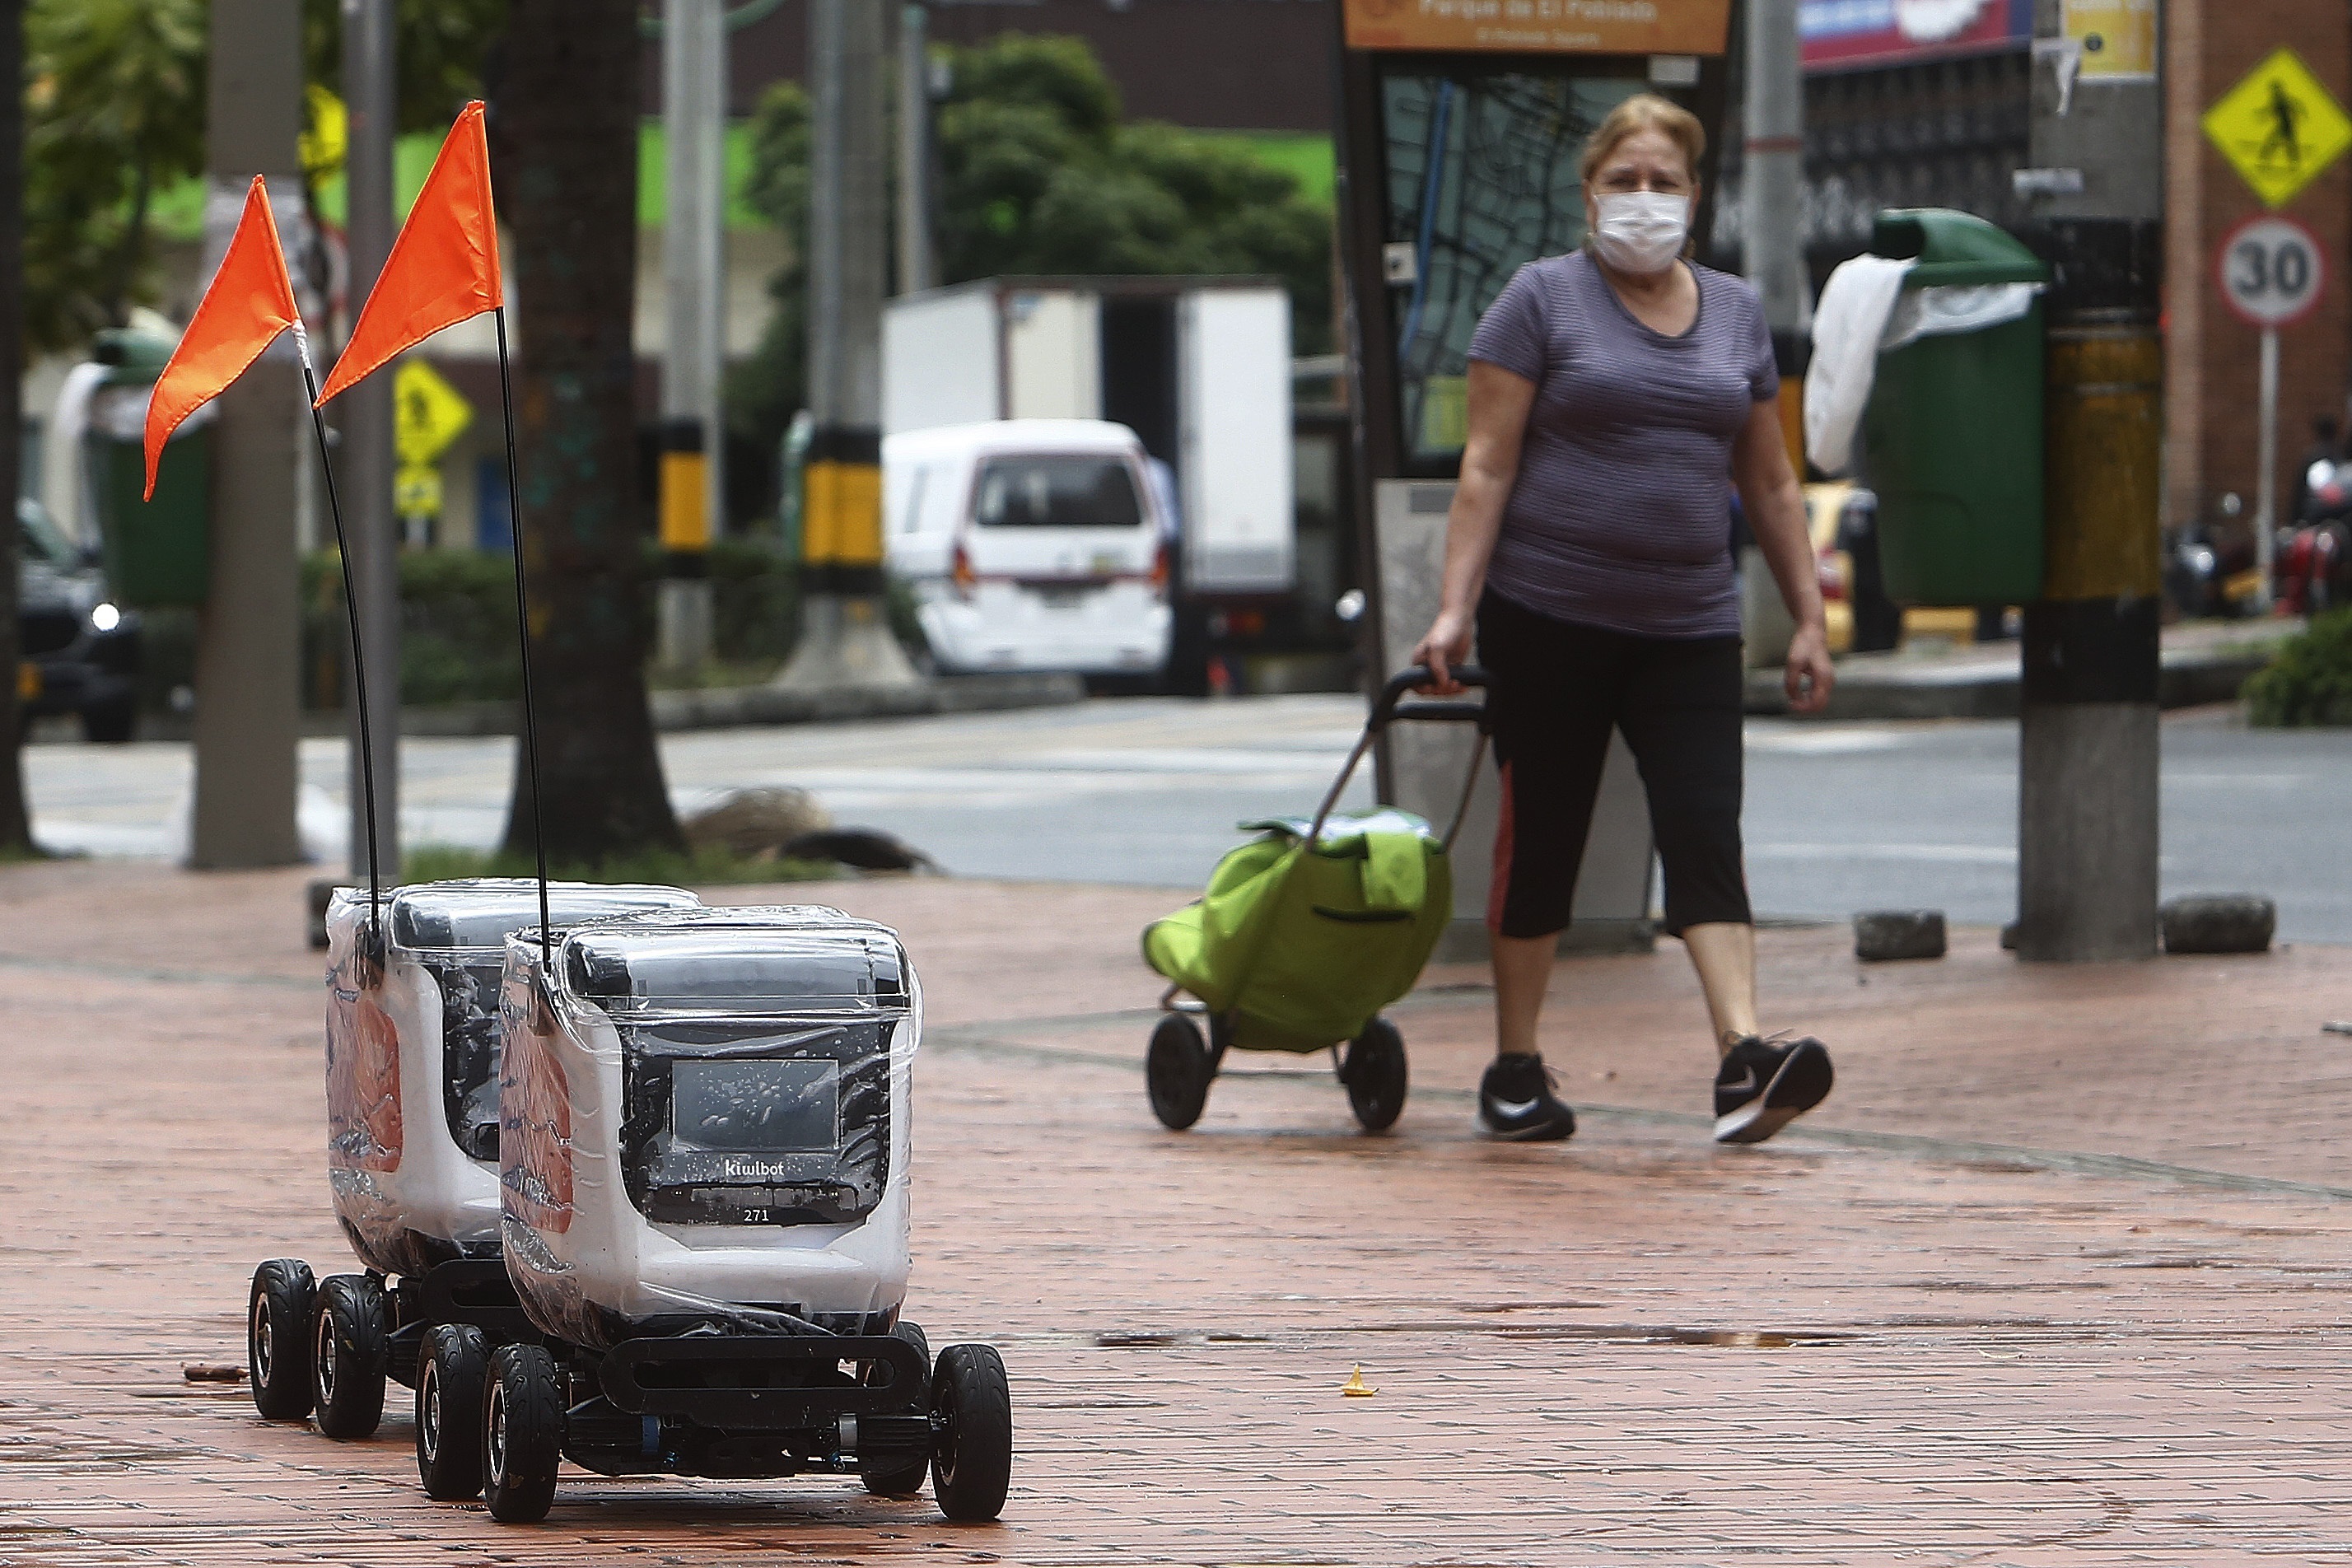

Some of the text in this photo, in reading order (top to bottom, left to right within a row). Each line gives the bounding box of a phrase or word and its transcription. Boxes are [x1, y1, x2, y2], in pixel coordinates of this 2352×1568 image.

[2231, 239, 2309, 300] 30
[726, 1159, 785, 1177] kiwibot
[744, 1209, 769, 1222] 271
